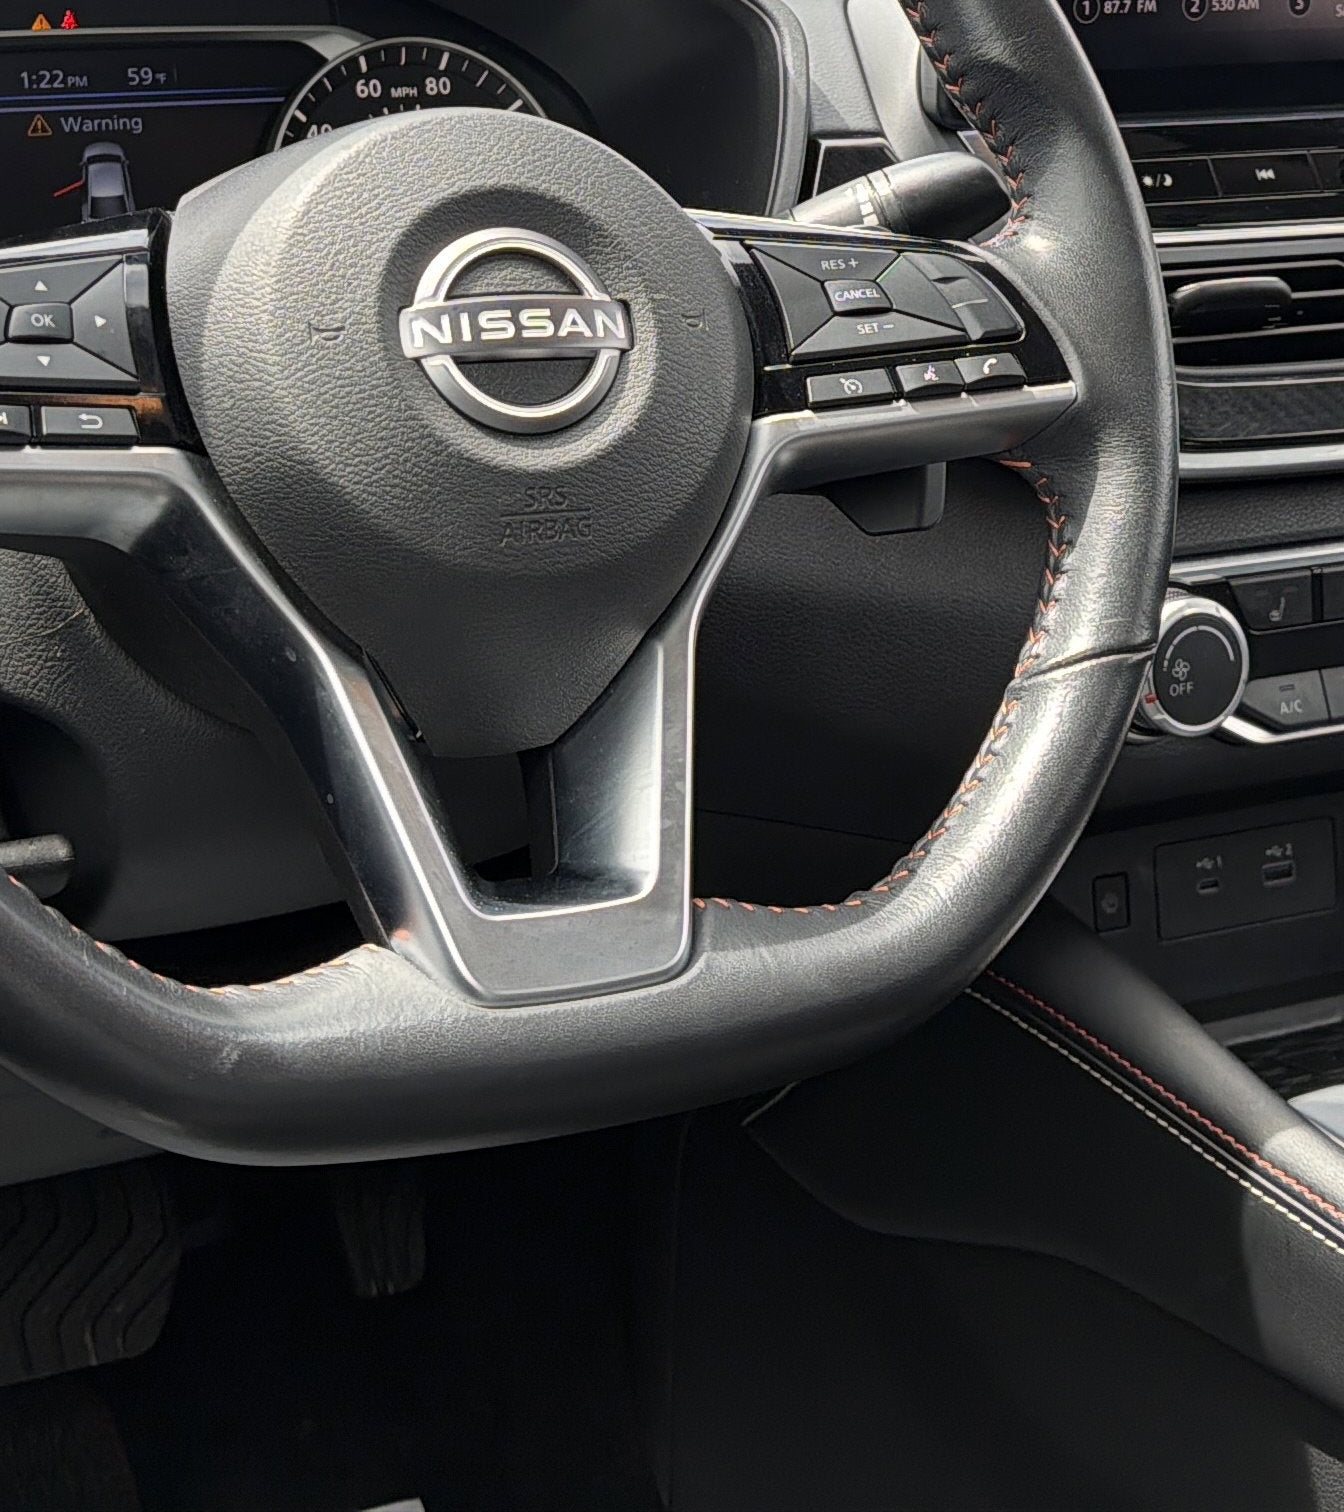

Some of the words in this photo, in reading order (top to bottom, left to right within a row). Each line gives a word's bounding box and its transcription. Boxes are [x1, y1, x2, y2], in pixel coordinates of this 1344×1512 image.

[1103, 0, 1131, 14] 87.7
[1136, 0, 1157, 14] FM
[20, 70, 65, 88] 1:22
[67, 76, 89, 88] PM
[127, 67, 153, 85] 59
[356, 78, 382, 98] 60
[390, 86, 418, 98] MPH
[424, 76, 451, 95] 80
[60, 115, 143, 134] Warning
[821, 259, 846, 271] RES
[834, 288, 881, 302] CANCEL
[30, 312, 56, 328] OK
[411, 307, 626, 348] NISSAN
[857, 323, 879, 335] SET
[1169, 681, 1194, 697] OFF
[1280, 699, 1303, 714] A/C
